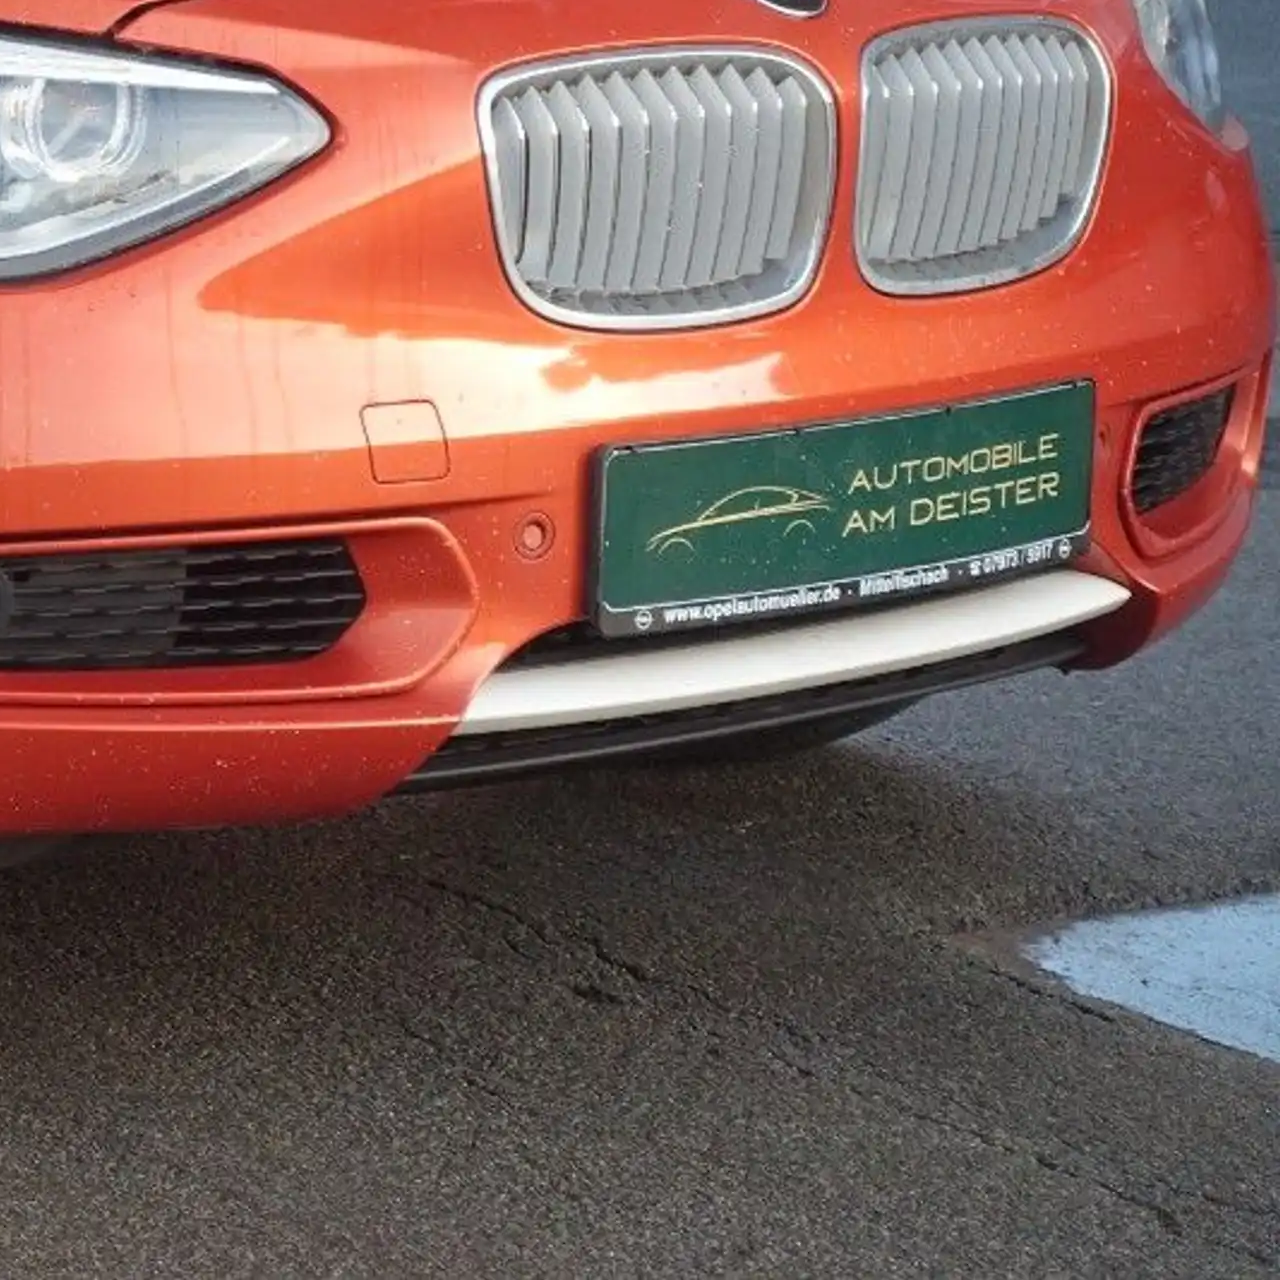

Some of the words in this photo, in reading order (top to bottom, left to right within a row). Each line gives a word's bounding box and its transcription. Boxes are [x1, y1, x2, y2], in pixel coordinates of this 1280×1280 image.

[847, 433, 1059, 495] AUTOMOBILE
[842, 506, 895, 538] AM
[910, 471, 1060, 526] DEISTER
[663, 585, 841, 624] www.opelautomueller.de
